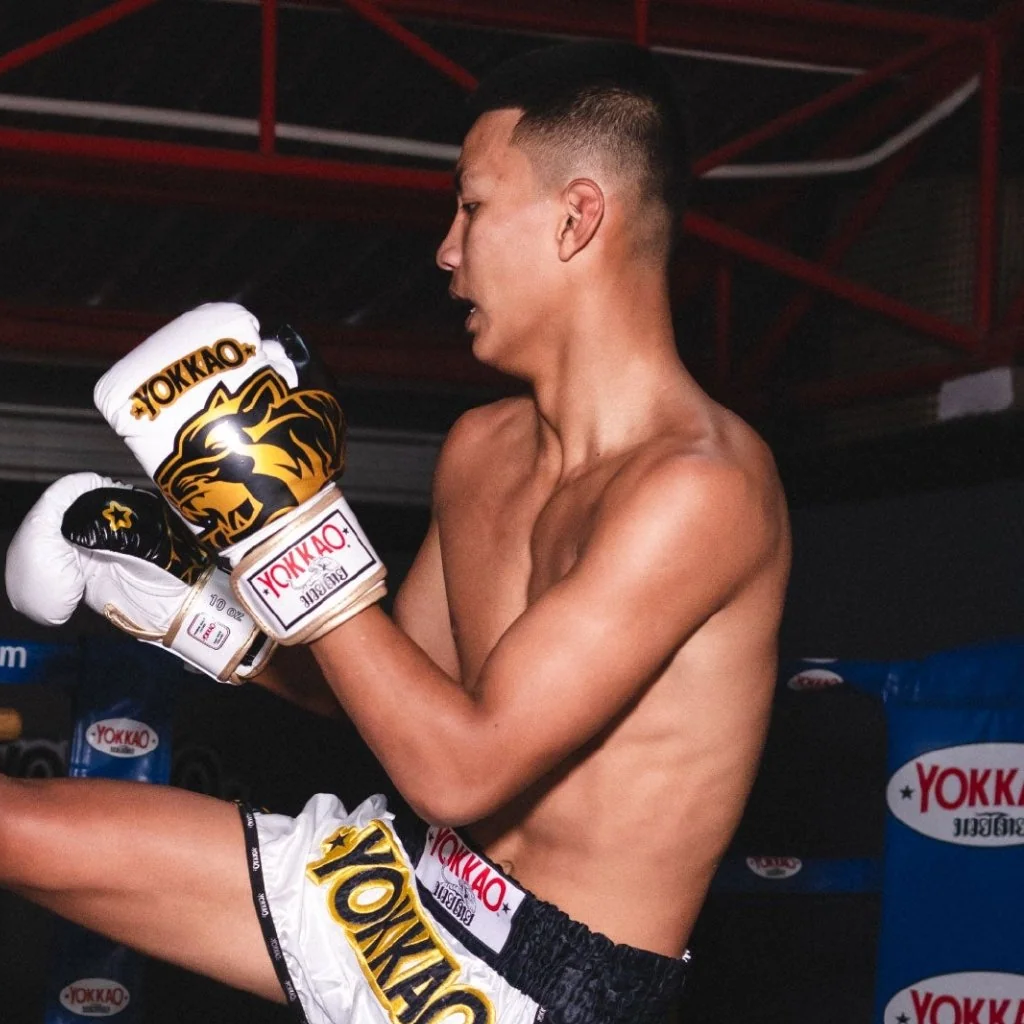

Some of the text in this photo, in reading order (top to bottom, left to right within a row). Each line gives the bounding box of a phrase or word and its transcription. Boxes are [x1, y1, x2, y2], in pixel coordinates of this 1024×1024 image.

[131, 339, 246, 418] YOKKAO
[257, 524, 346, 599] YOKKAO
[209, 593, 227, 611] 10
[96, 724, 150, 749] YOKKAO
[915, 761, 1024, 814] YOKK
[430, 827, 507, 912] YOKKAO
[69, 986, 124, 1006] YOKKAO
